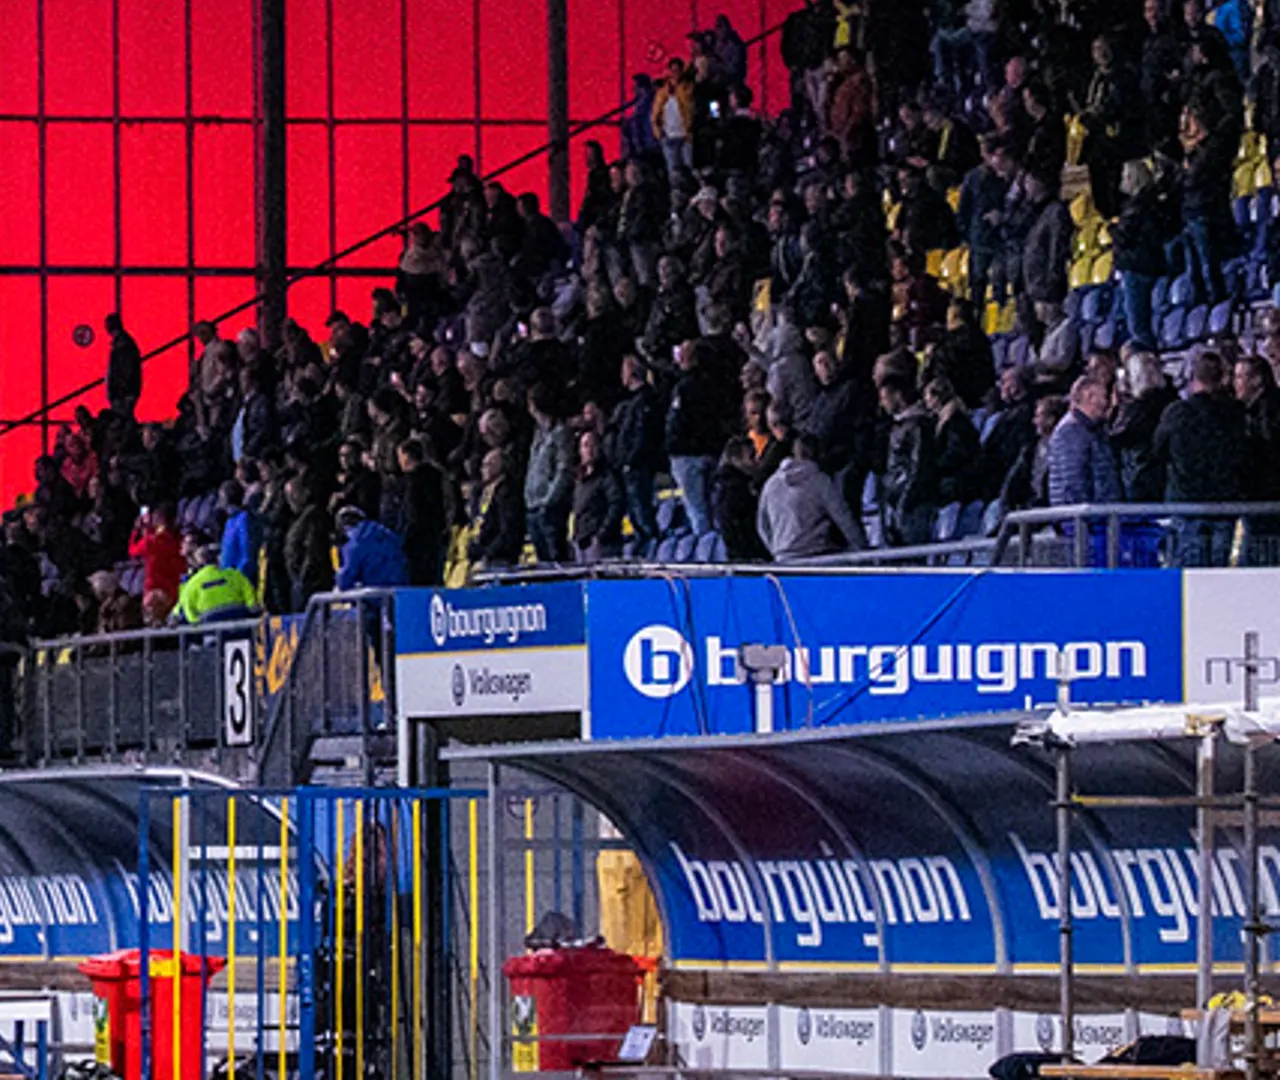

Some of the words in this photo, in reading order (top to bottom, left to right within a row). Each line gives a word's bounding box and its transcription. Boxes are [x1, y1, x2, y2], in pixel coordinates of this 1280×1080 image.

[445, 603, 547, 644] bourguignon
[229, 637, 247, 735] 3
[668, 840, 972, 947] bourguignon
